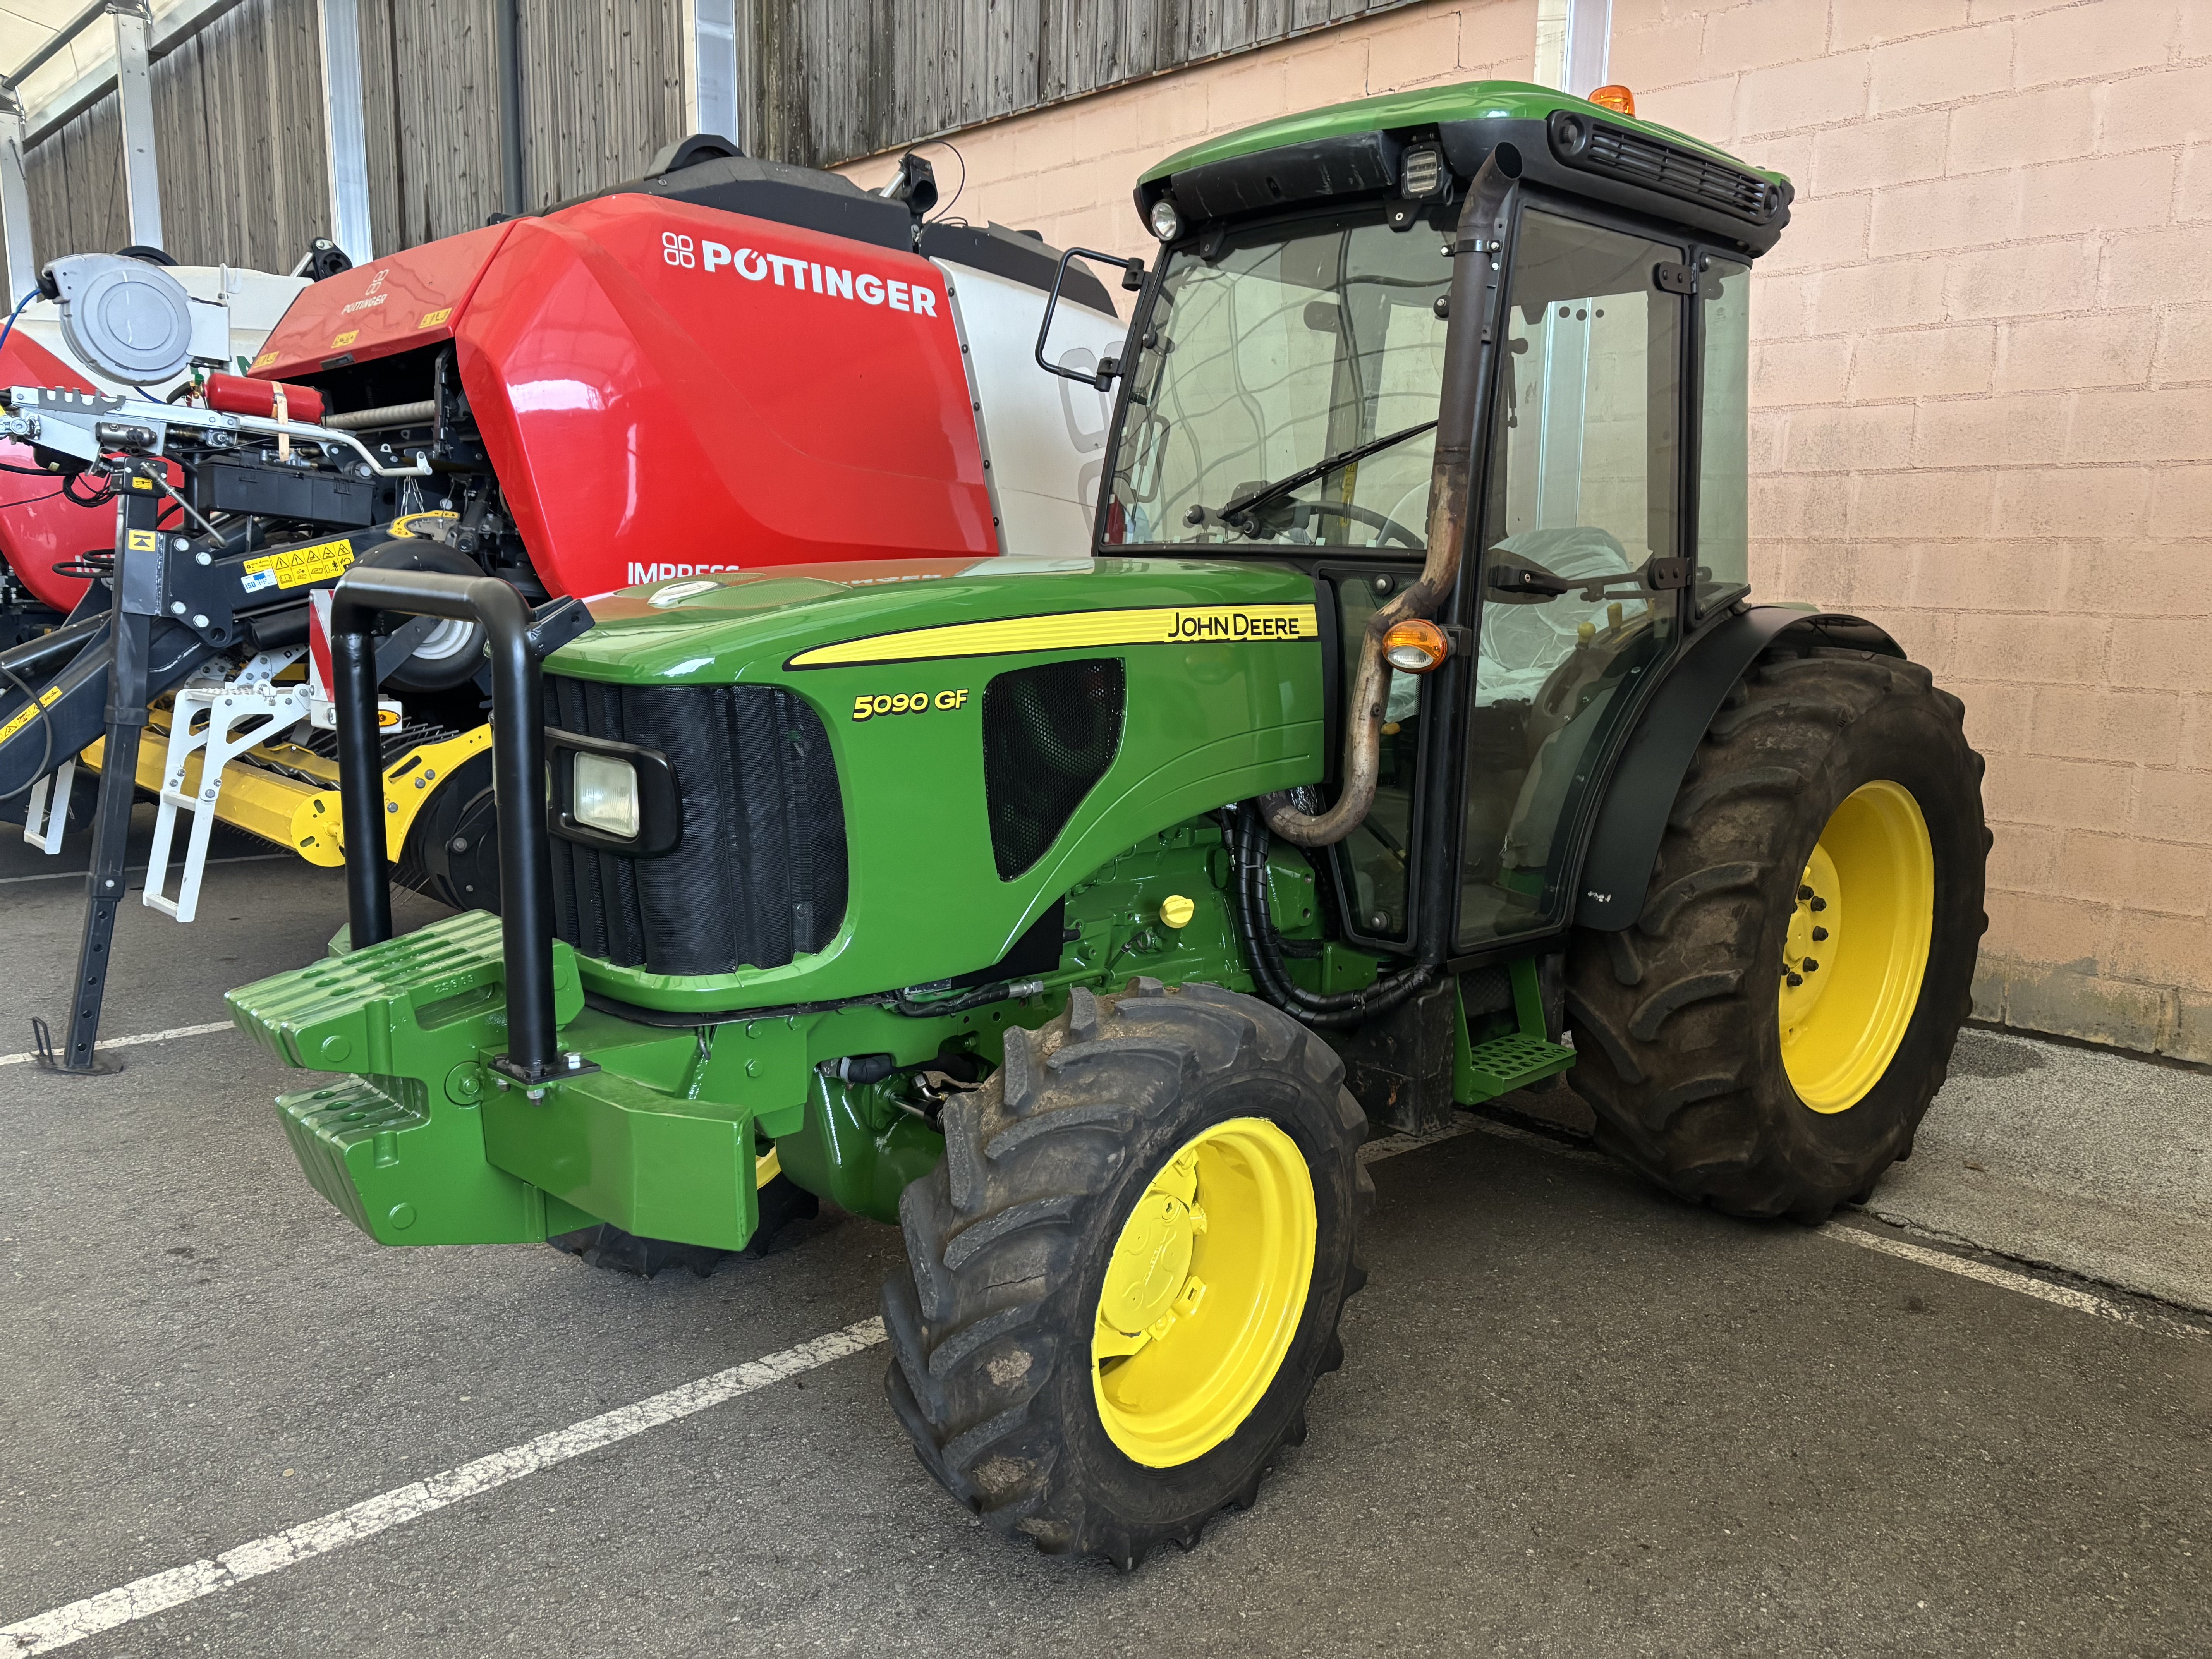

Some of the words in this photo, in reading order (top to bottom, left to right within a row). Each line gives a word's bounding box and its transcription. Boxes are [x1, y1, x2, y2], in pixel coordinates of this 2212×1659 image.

[1168, 612, 1228, 637] JOHN
[1233, 613, 1300, 636] DEERE
[852, 692, 930, 722] 5090
[934, 688, 969, 711] GF
